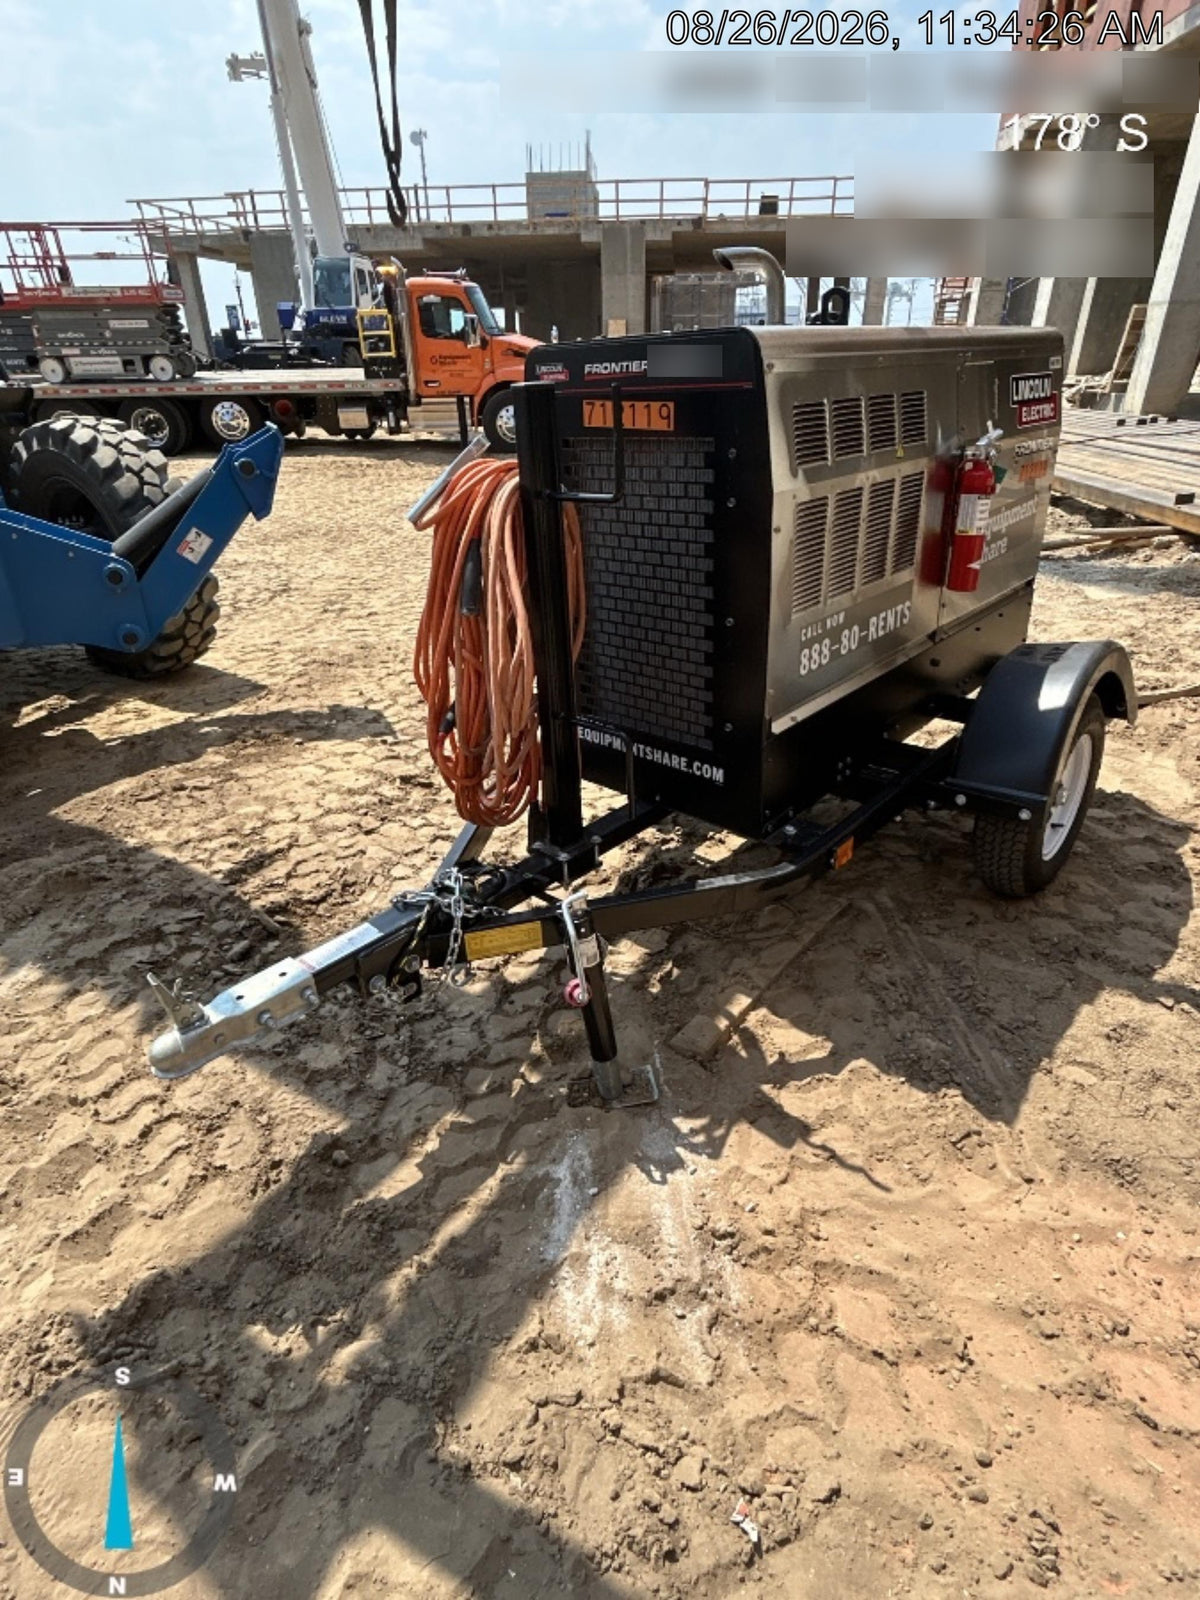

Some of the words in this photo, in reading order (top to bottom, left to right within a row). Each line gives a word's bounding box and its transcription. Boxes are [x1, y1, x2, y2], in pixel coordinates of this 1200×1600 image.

[1012, 378, 1052, 401] LINCOLN
[585, 401, 671, 429] 71119
[983, 494, 1038, 540] quipment
[981, 536, 1008, 562] hare
[799, 600, 912, 676] 888-80-RENTS
[801, 622, 823, 642] CALL
[826, 610, 846, 629] NOW
